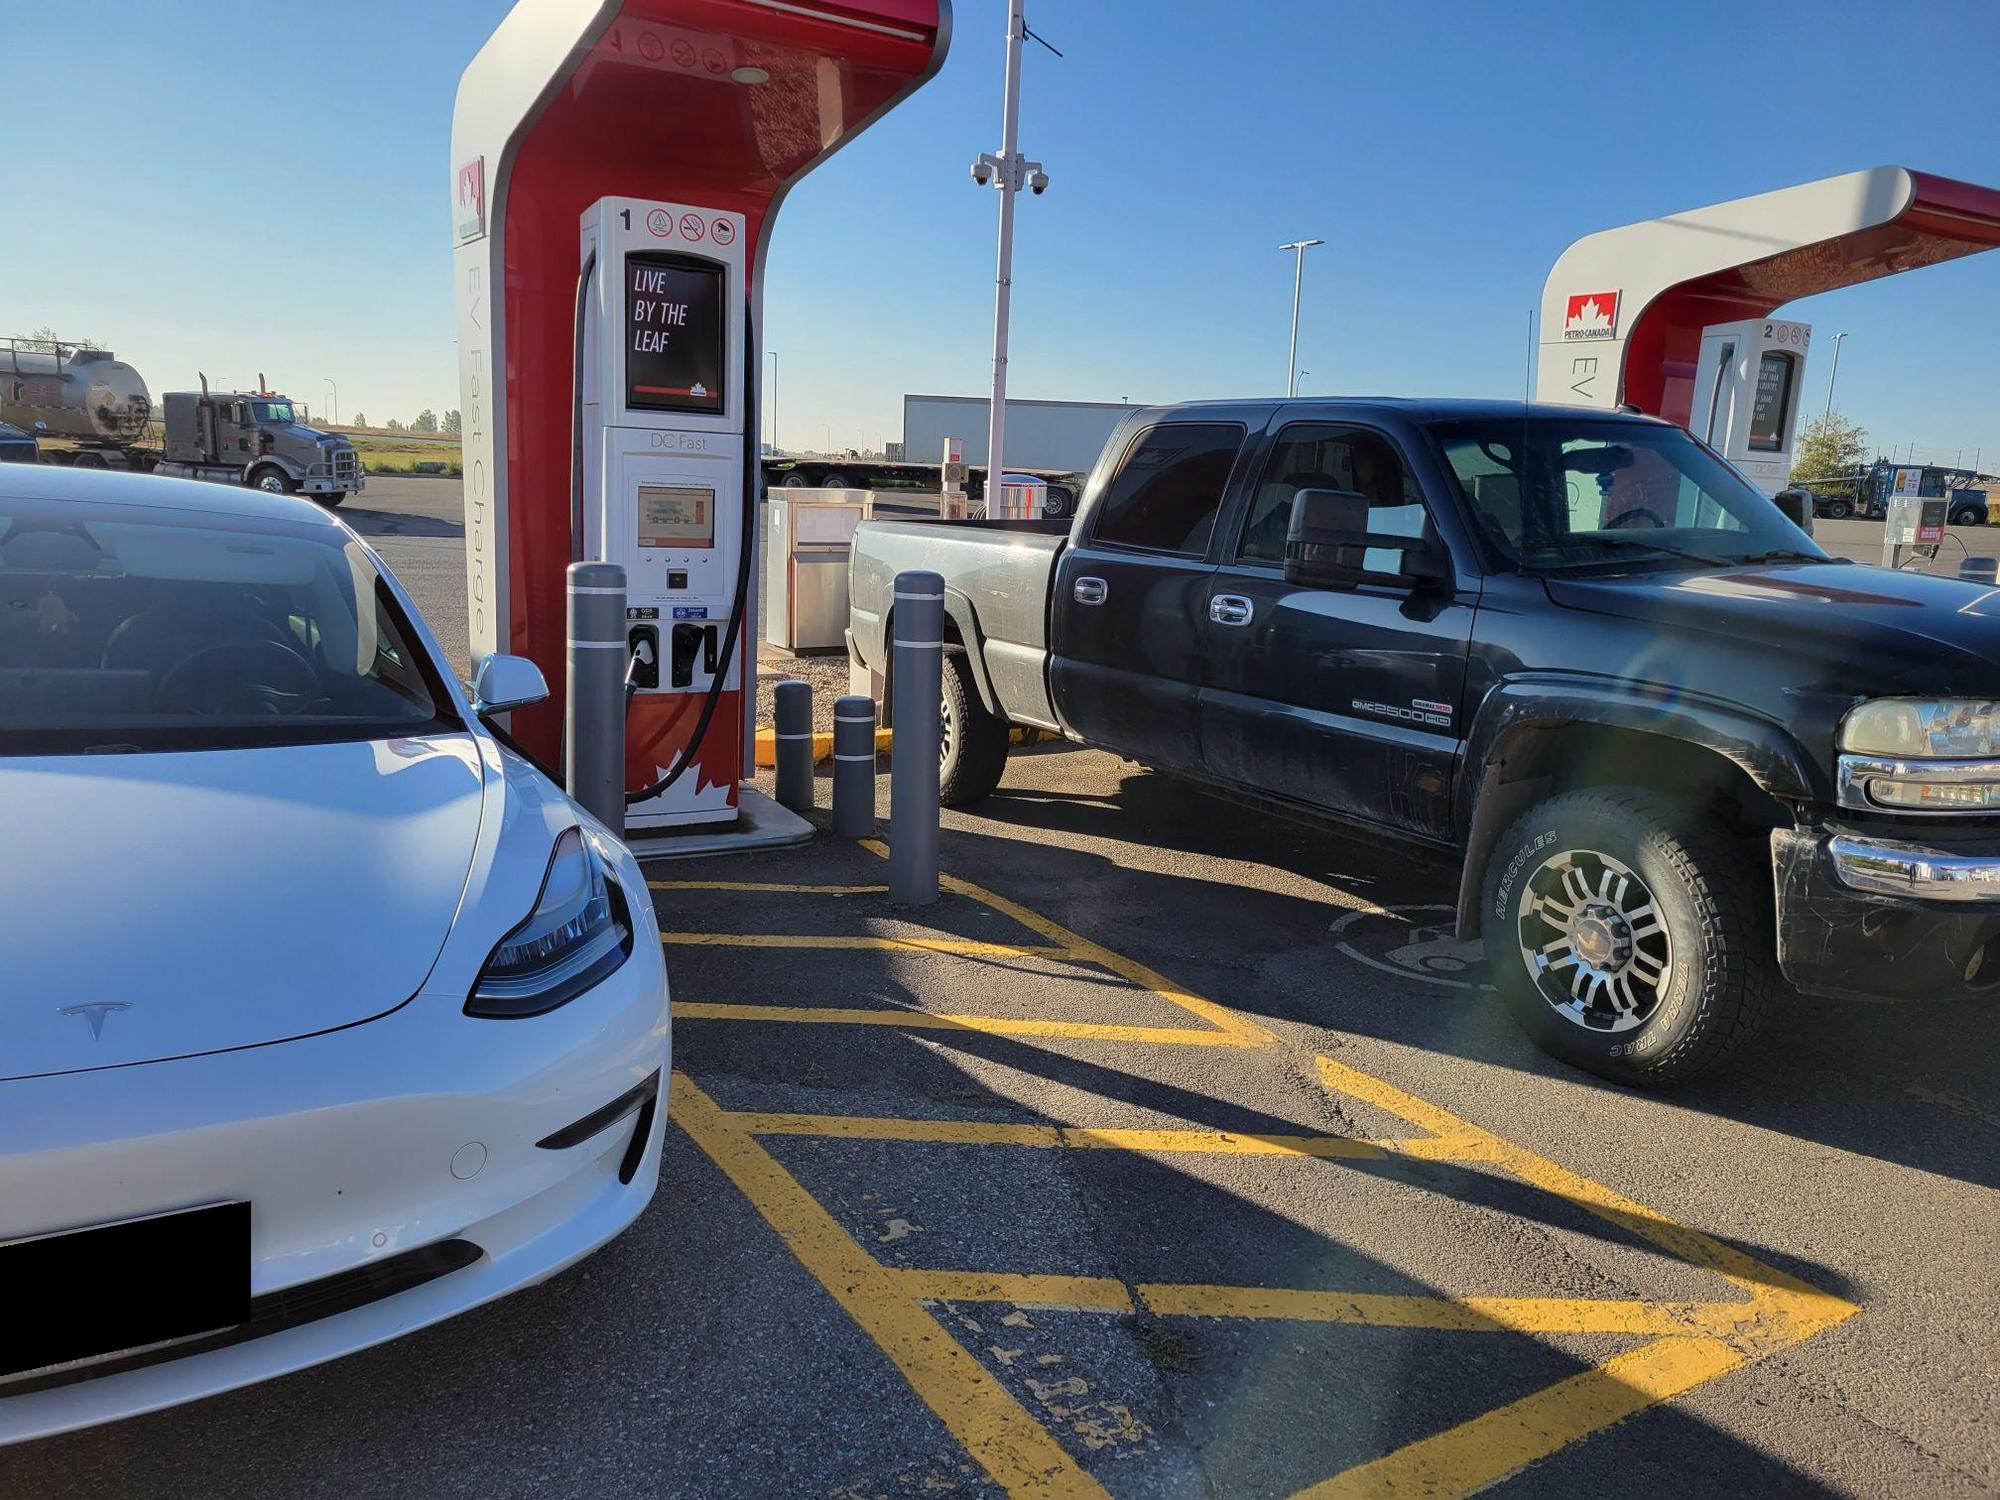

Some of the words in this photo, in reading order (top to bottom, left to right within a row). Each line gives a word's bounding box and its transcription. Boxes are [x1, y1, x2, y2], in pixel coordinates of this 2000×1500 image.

[619, 208, 631, 231] 1
[634, 269, 667, 294] LIVE
[468, 266, 481, 330] EV
[634, 299, 657, 323] BY
[661, 302, 689, 326] THE
[634, 329, 670, 353] LEAF
[1764, 324, 1773, 338] 2
[1571, 357, 1598, 399] EV
[470, 349, 482, 443] Fast
[651, 432, 675, 448] DC
[679, 434, 707, 450] Fast
[473, 459, 485, 635] Charge
[1352, 700, 1375, 711] GMC
[1374, 703, 1424, 721] 2500
[1495, 830, 1558, 920] HERCULES
[1659, 961, 1690, 1032] TERRA
[1609, 1031, 1658, 1057] TRAC
